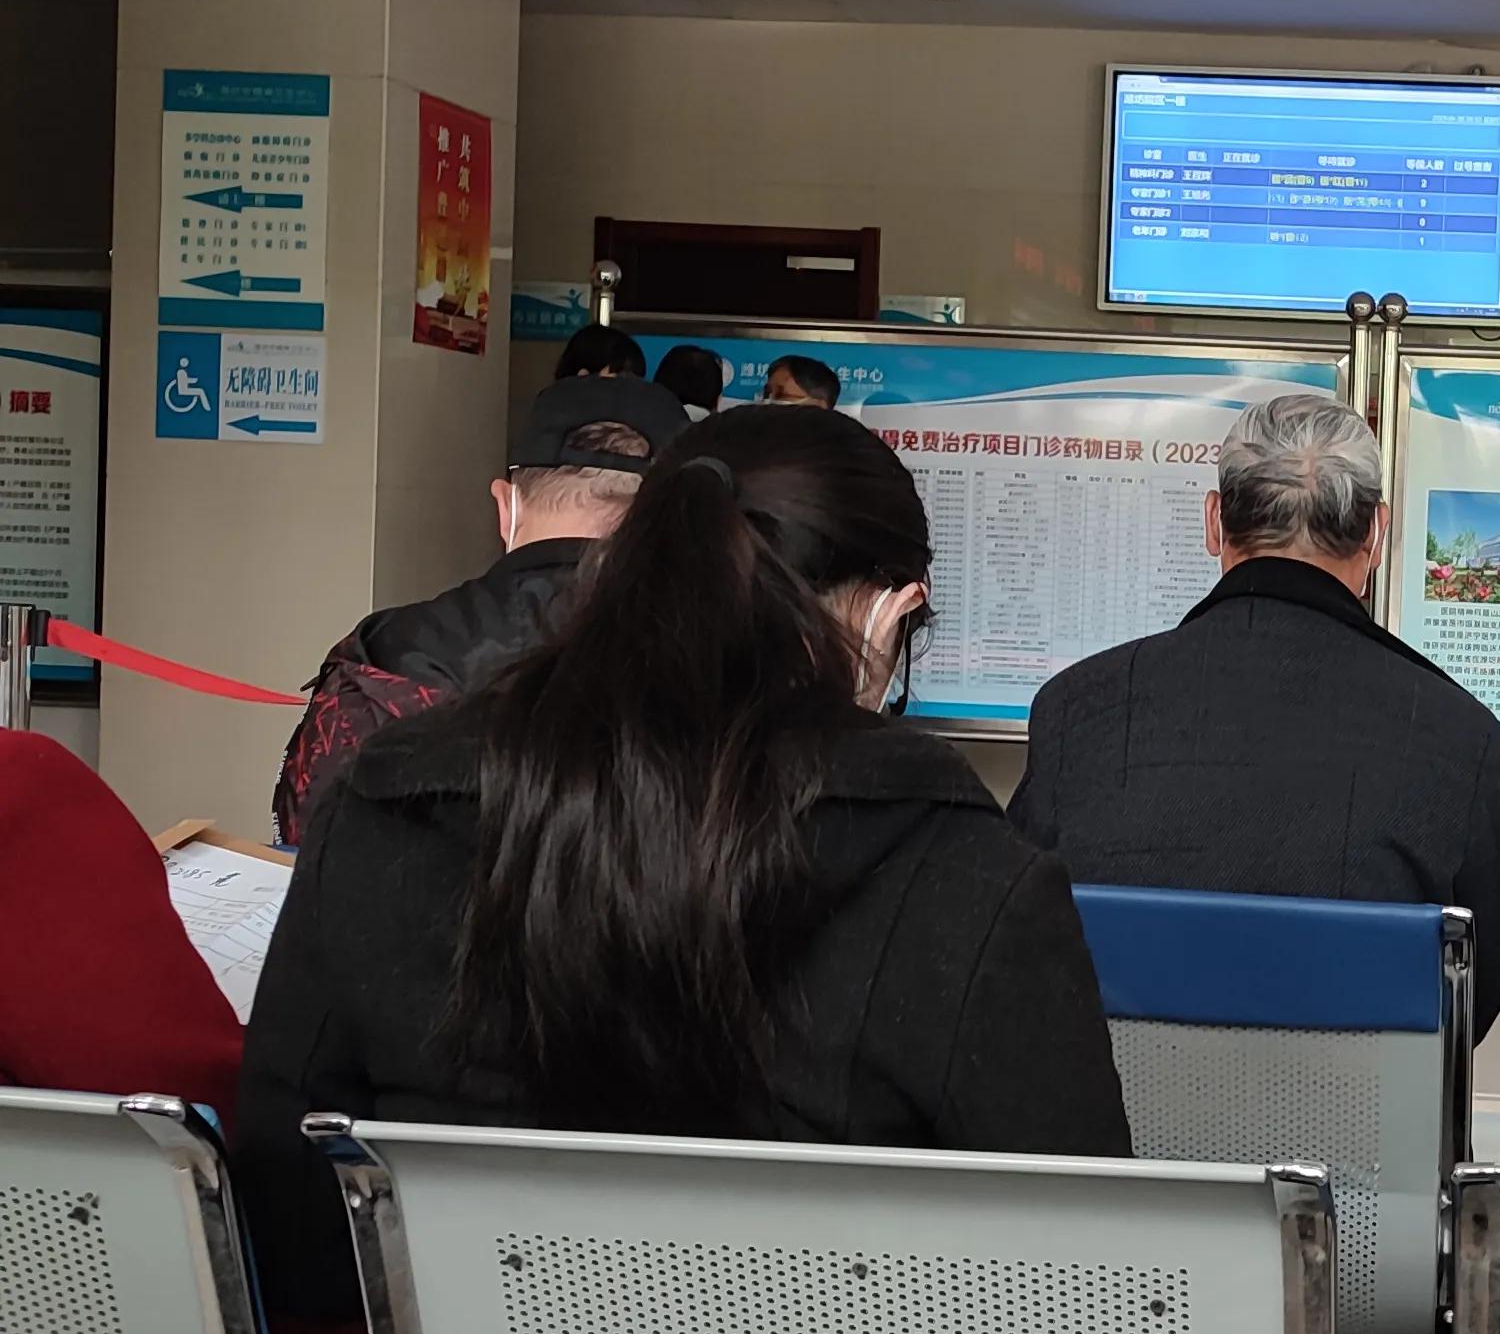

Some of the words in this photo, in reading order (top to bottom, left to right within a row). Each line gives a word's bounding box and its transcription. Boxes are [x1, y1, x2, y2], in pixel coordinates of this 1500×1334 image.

[225, 366, 319, 397] 无障碍卫生间
[9, 390, 51, 414] 摘要
